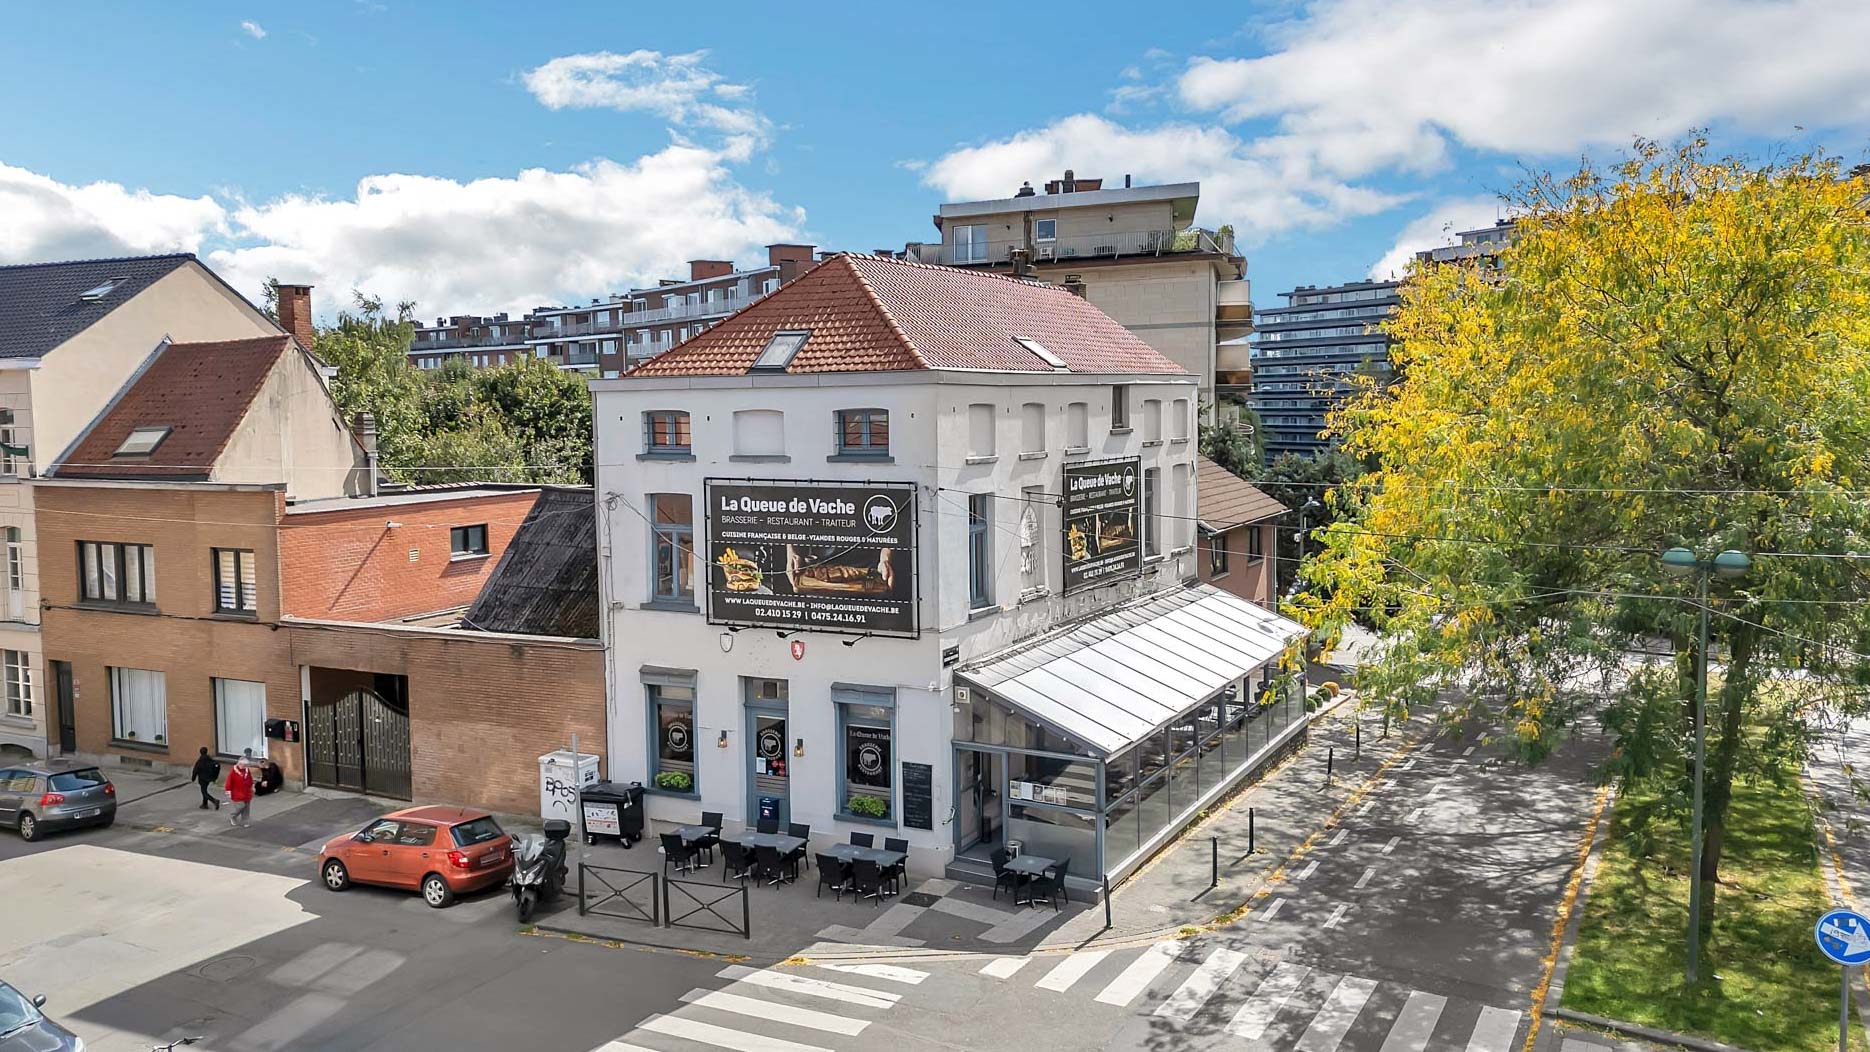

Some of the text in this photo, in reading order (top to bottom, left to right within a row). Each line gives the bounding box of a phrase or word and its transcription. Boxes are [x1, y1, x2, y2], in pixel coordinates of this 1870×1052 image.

[1070, 472, 1121, 491] La Queue de Vache
[721, 496, 855, 514] La Queue de Vache
[721, 515, 758, 525] BRASSERIE
[767, 516, 813, 526] RESTAURANT
[822, 518, 856, 528] TRAITEUR
[747, 532, 781, 540] FRANÇAISE
[836, 535, 860, 543] ROUGES
[810, 602, 900, 614] INFO@LAQUEUEDEVACHE.BE
[755, 608, 780, 617] 02.410
[782, 609, 791, 618] 15
[792, 610, 801, 619] 29
[811, 612, 866, 623] 0475.24.16.91
